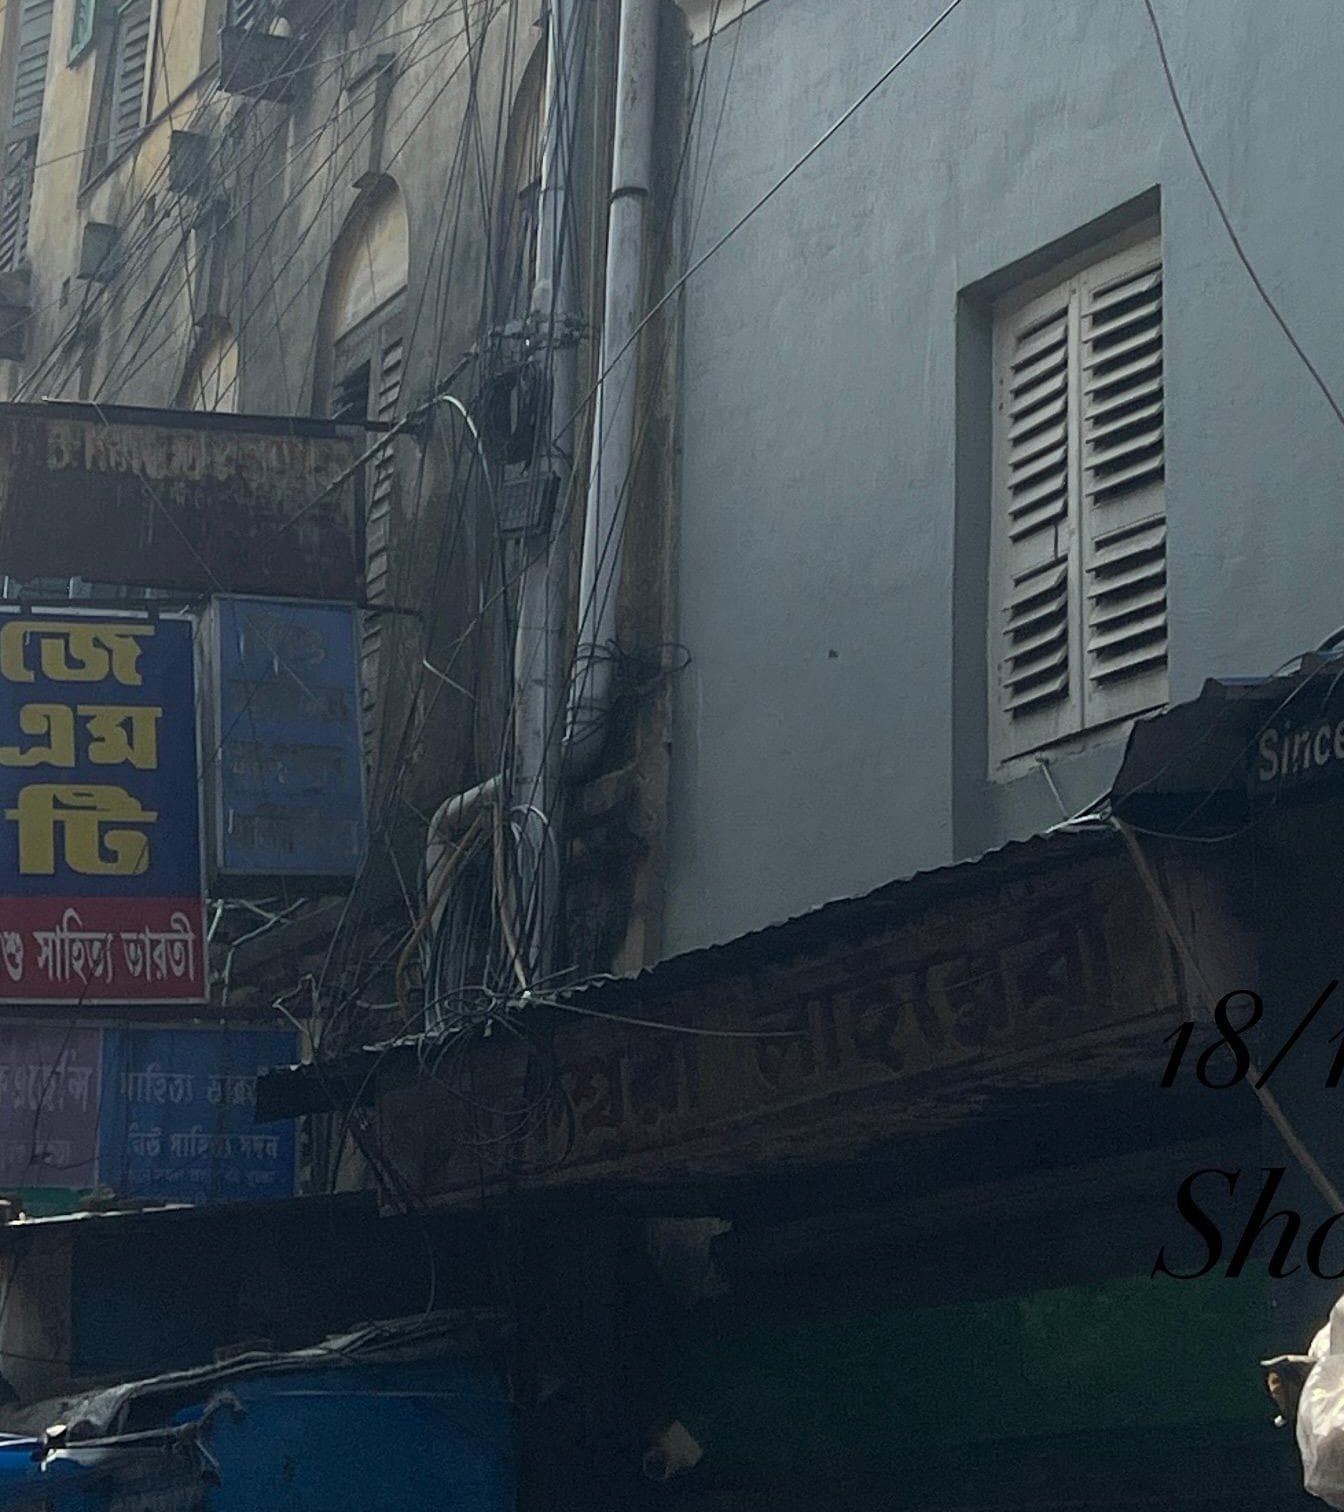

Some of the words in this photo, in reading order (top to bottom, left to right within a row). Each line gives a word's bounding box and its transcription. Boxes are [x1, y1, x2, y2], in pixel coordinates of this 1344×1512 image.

[0, 621, 155, 685] জে
[3, 783, 158, 875] টি
[33, 906, 114, 985] সাহিত্য
[119, 910, 197, 983] ভারতী
